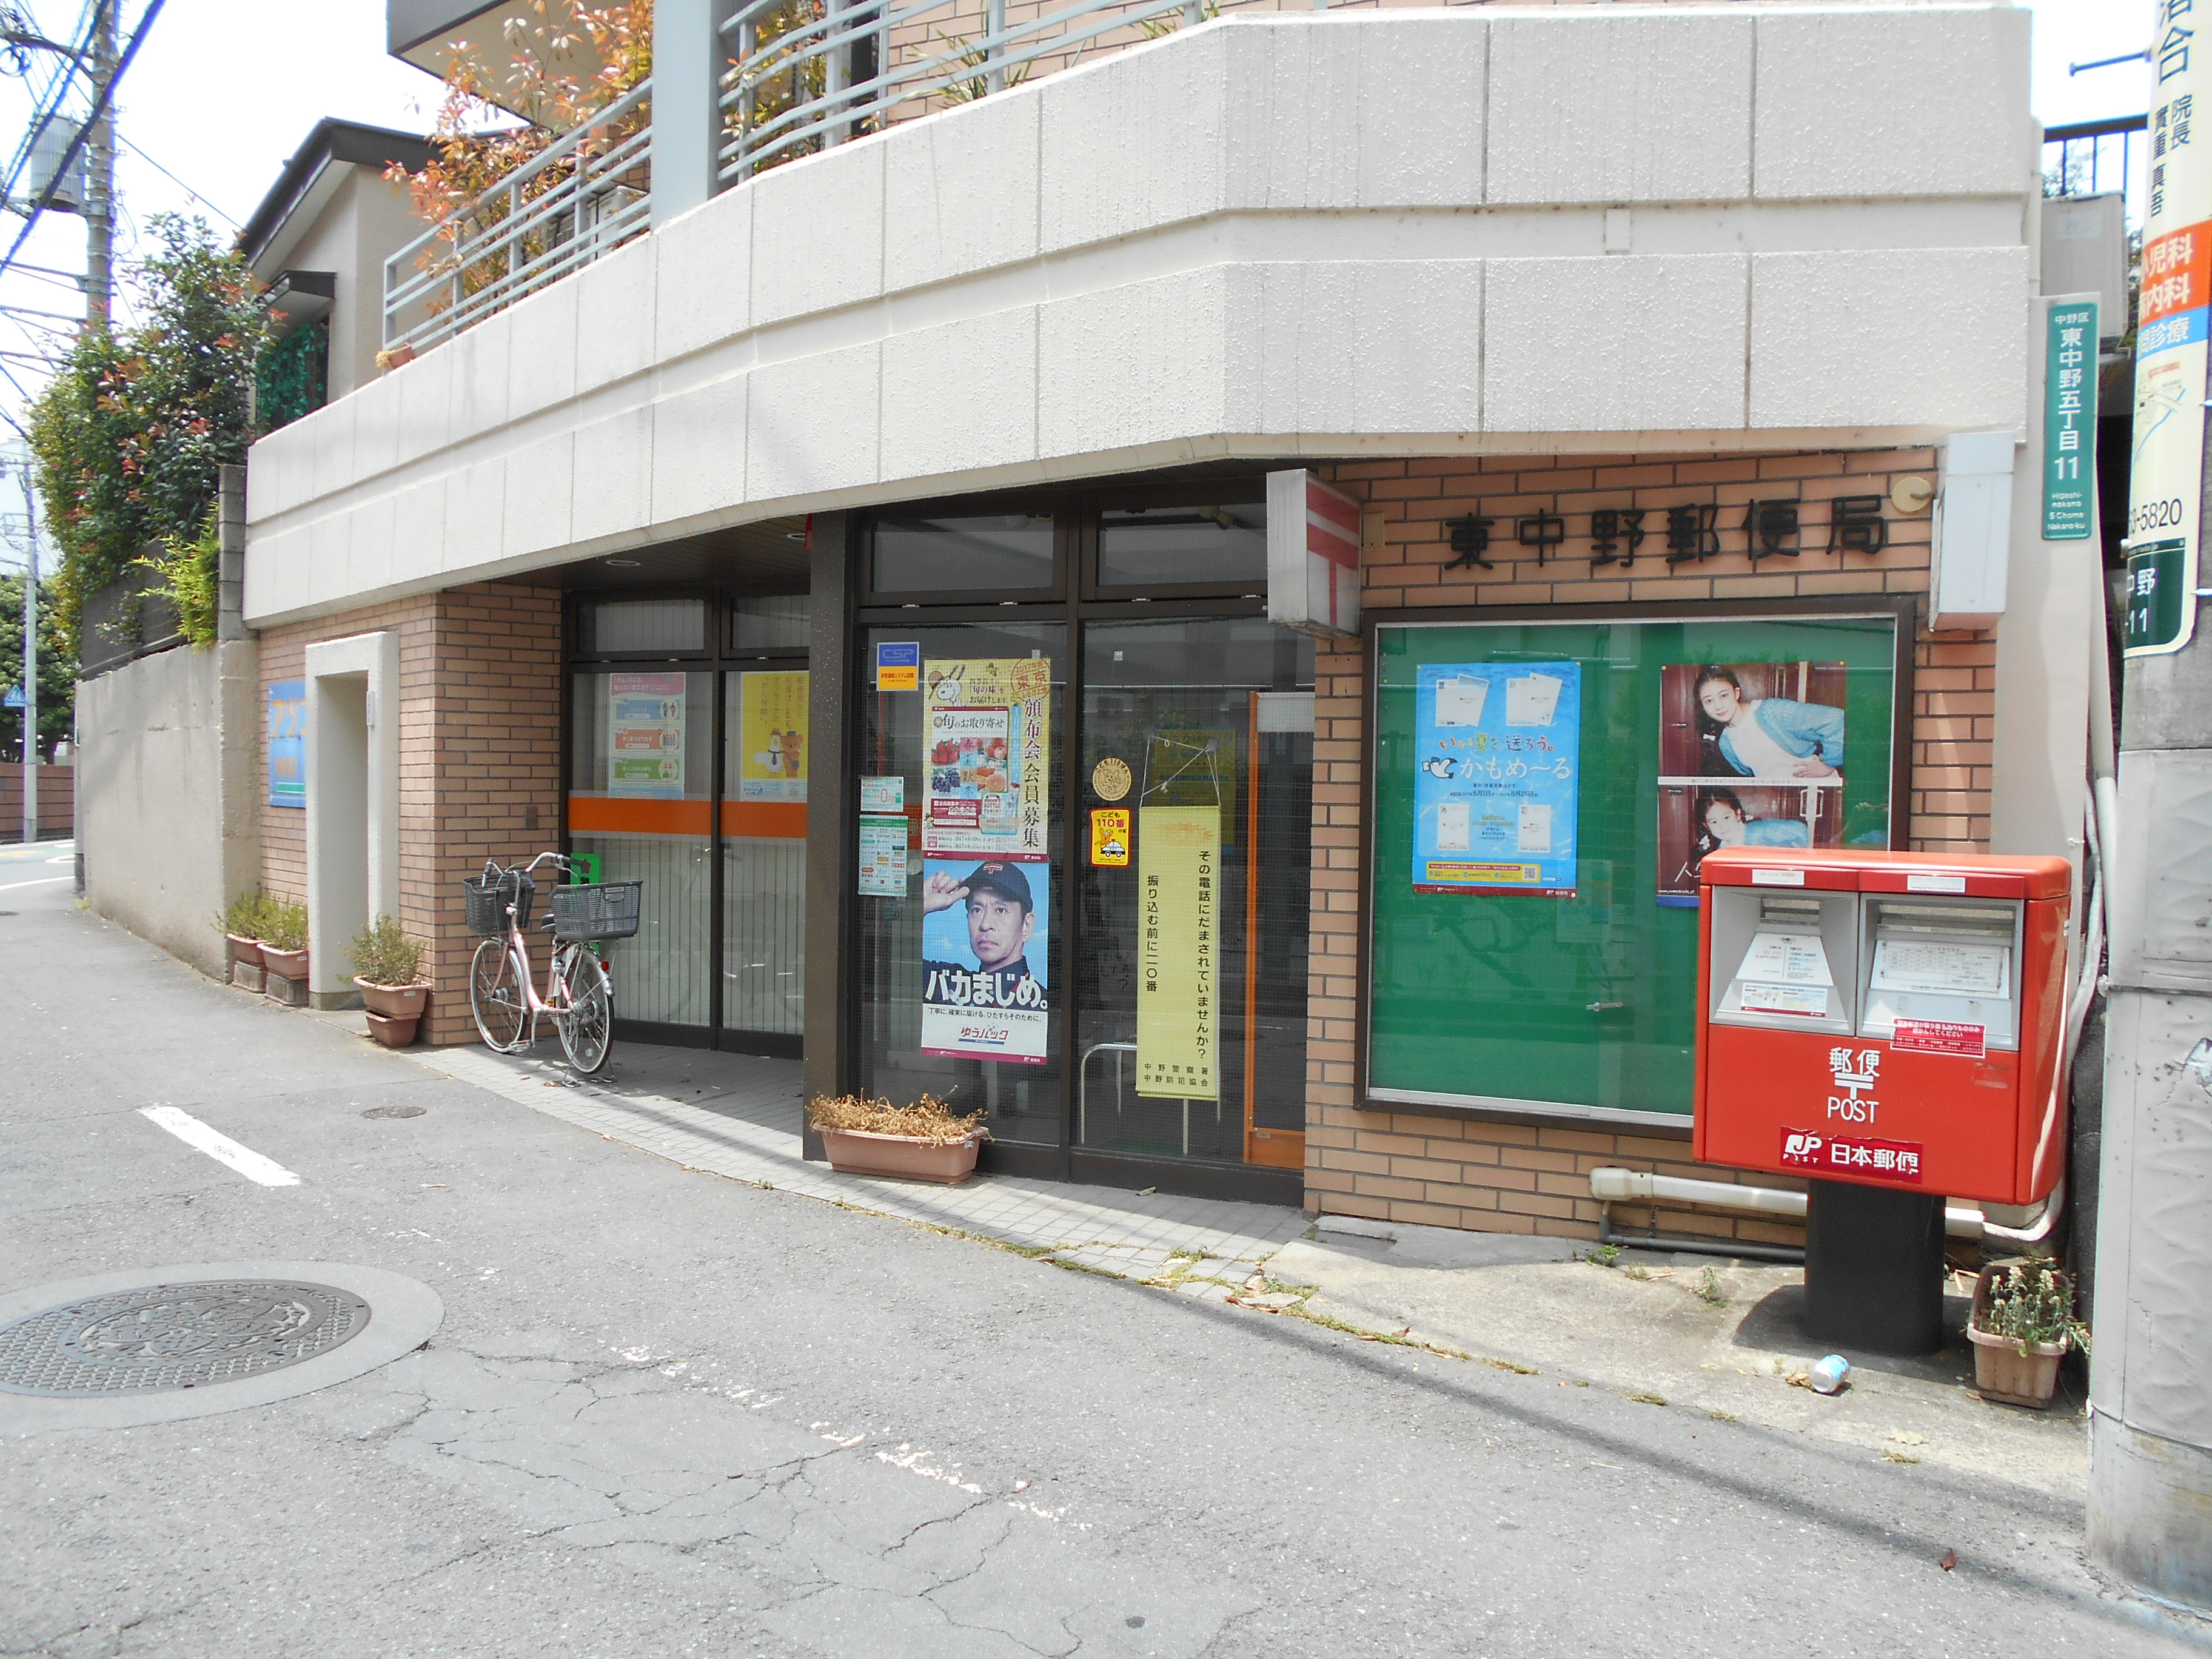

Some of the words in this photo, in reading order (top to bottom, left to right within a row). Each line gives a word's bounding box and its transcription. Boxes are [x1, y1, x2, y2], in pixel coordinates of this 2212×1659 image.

[2171, 93, 2193, 151] 院長
[2054, 312, 2090, 324] 中野区
[2054, 456, 2080, 480] 11
[1444, 494, 1888, 570] 東中野郵便局
[882, 649, 914, 659] CSP
[1016, 670, 1048, 690] 東京
[942, 714, 1005, 729] 旬のお取り寄せ
[1096, 819, 1125, 828] 110番
[925, 969, 1048, 1010] バカまじめ。
[960, 1027, 1009, 1041] ゆうパック
[1829, 1047, 1880, 1078] 郵便
[1828, 1096, 1879, 1124] POST
[1831, 1143, 1919, 1175] 日本郵便
